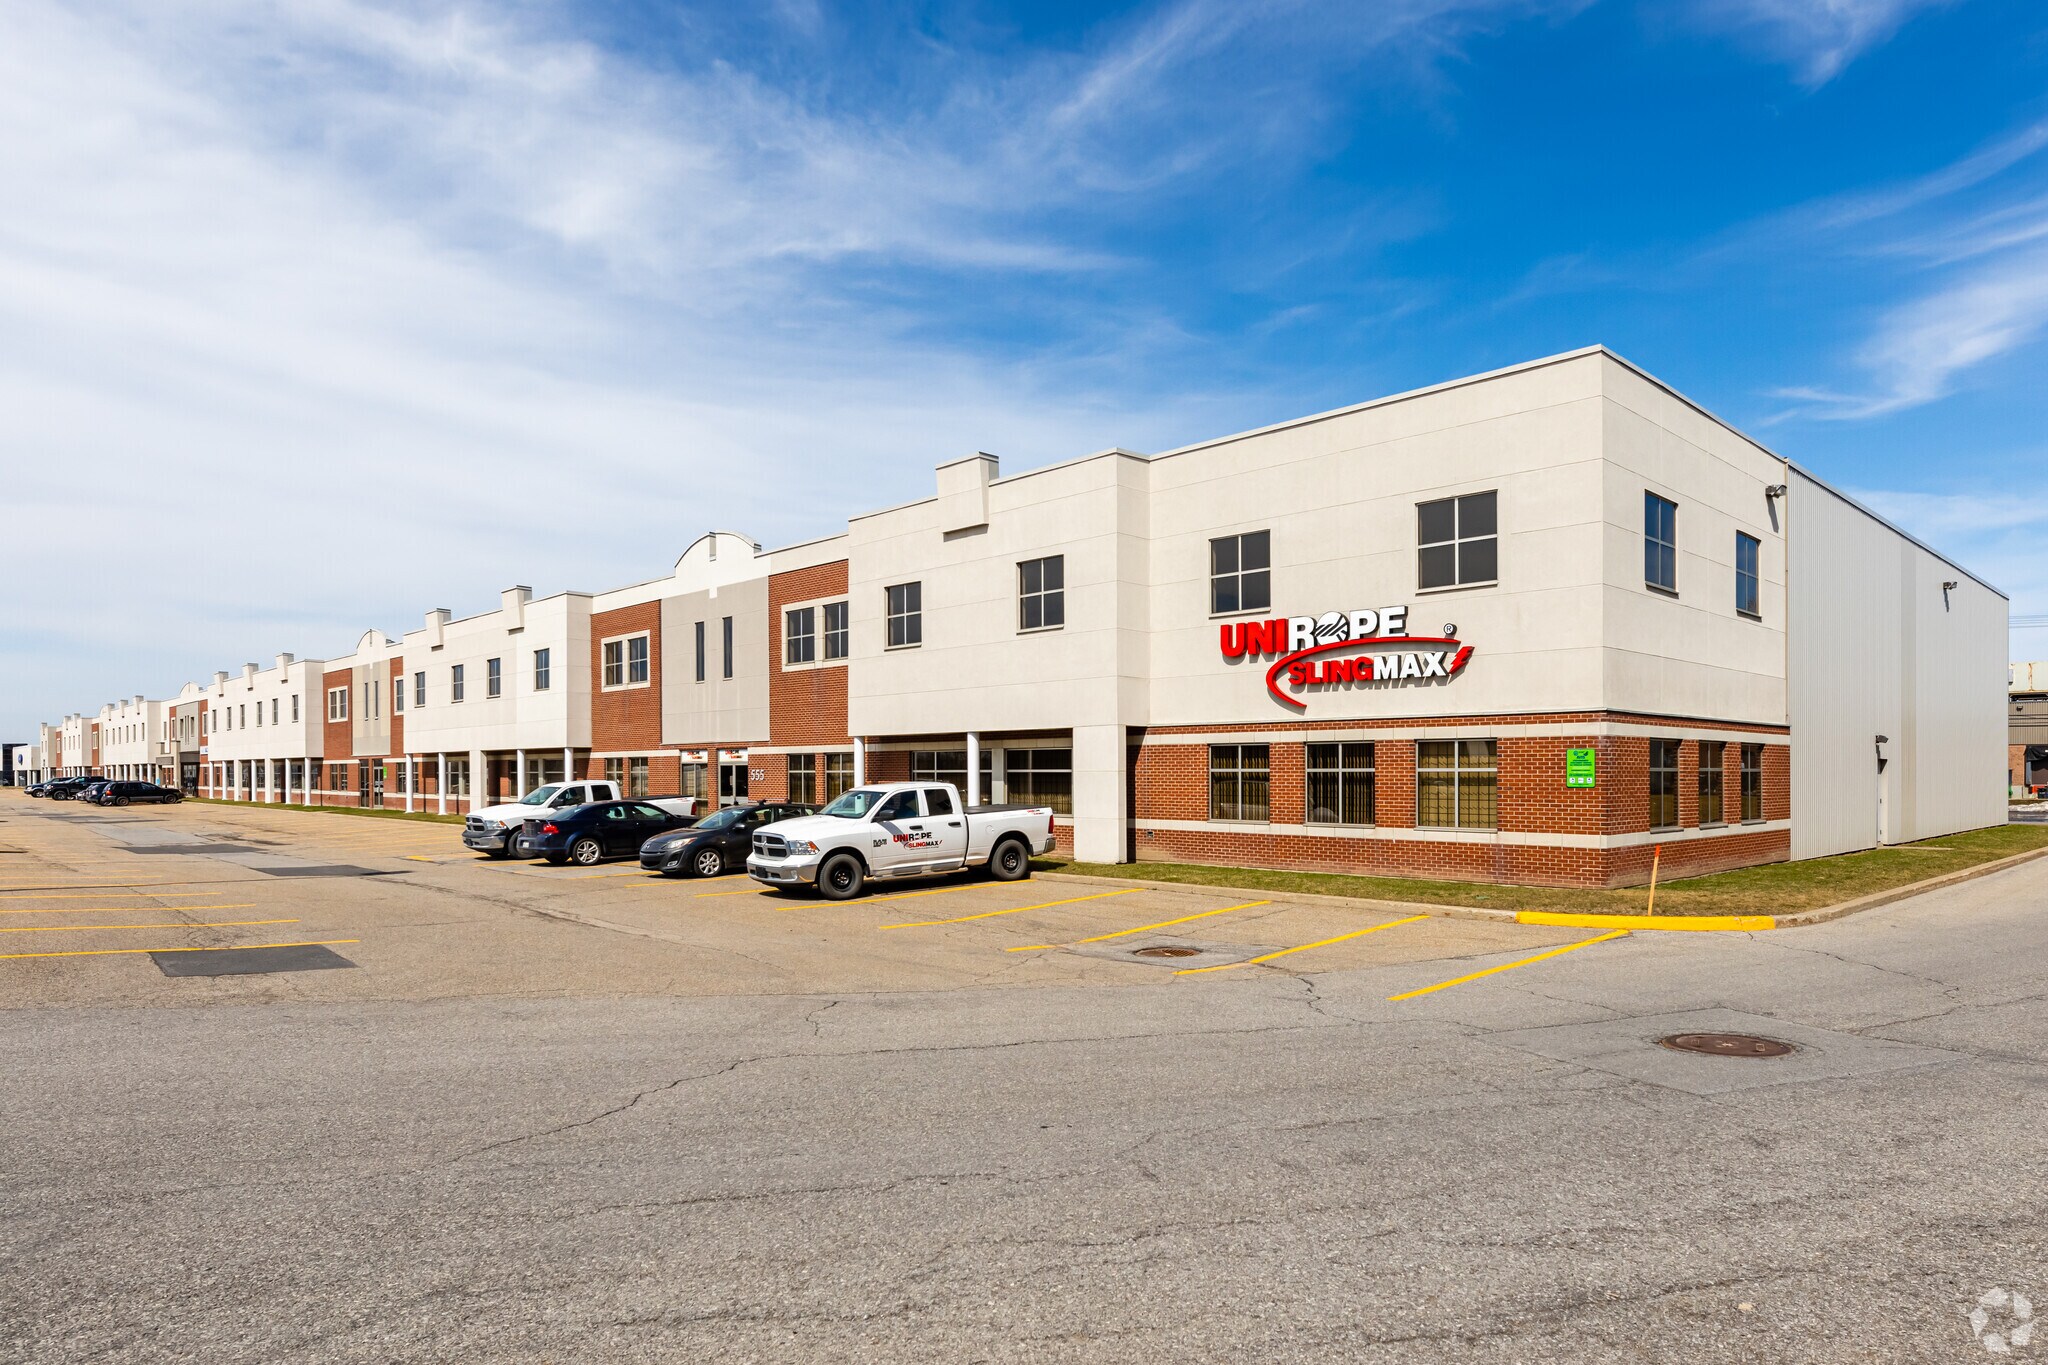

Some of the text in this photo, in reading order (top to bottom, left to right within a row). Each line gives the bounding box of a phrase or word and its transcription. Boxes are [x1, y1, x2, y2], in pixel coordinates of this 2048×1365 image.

[1220, 606, 1408, 657] UNIROPE
[1288, 651, 1449, 685] SLINGMAX
[751, 769, 764, 780] 555
[893, 832, 932, 842] UNIROPE
